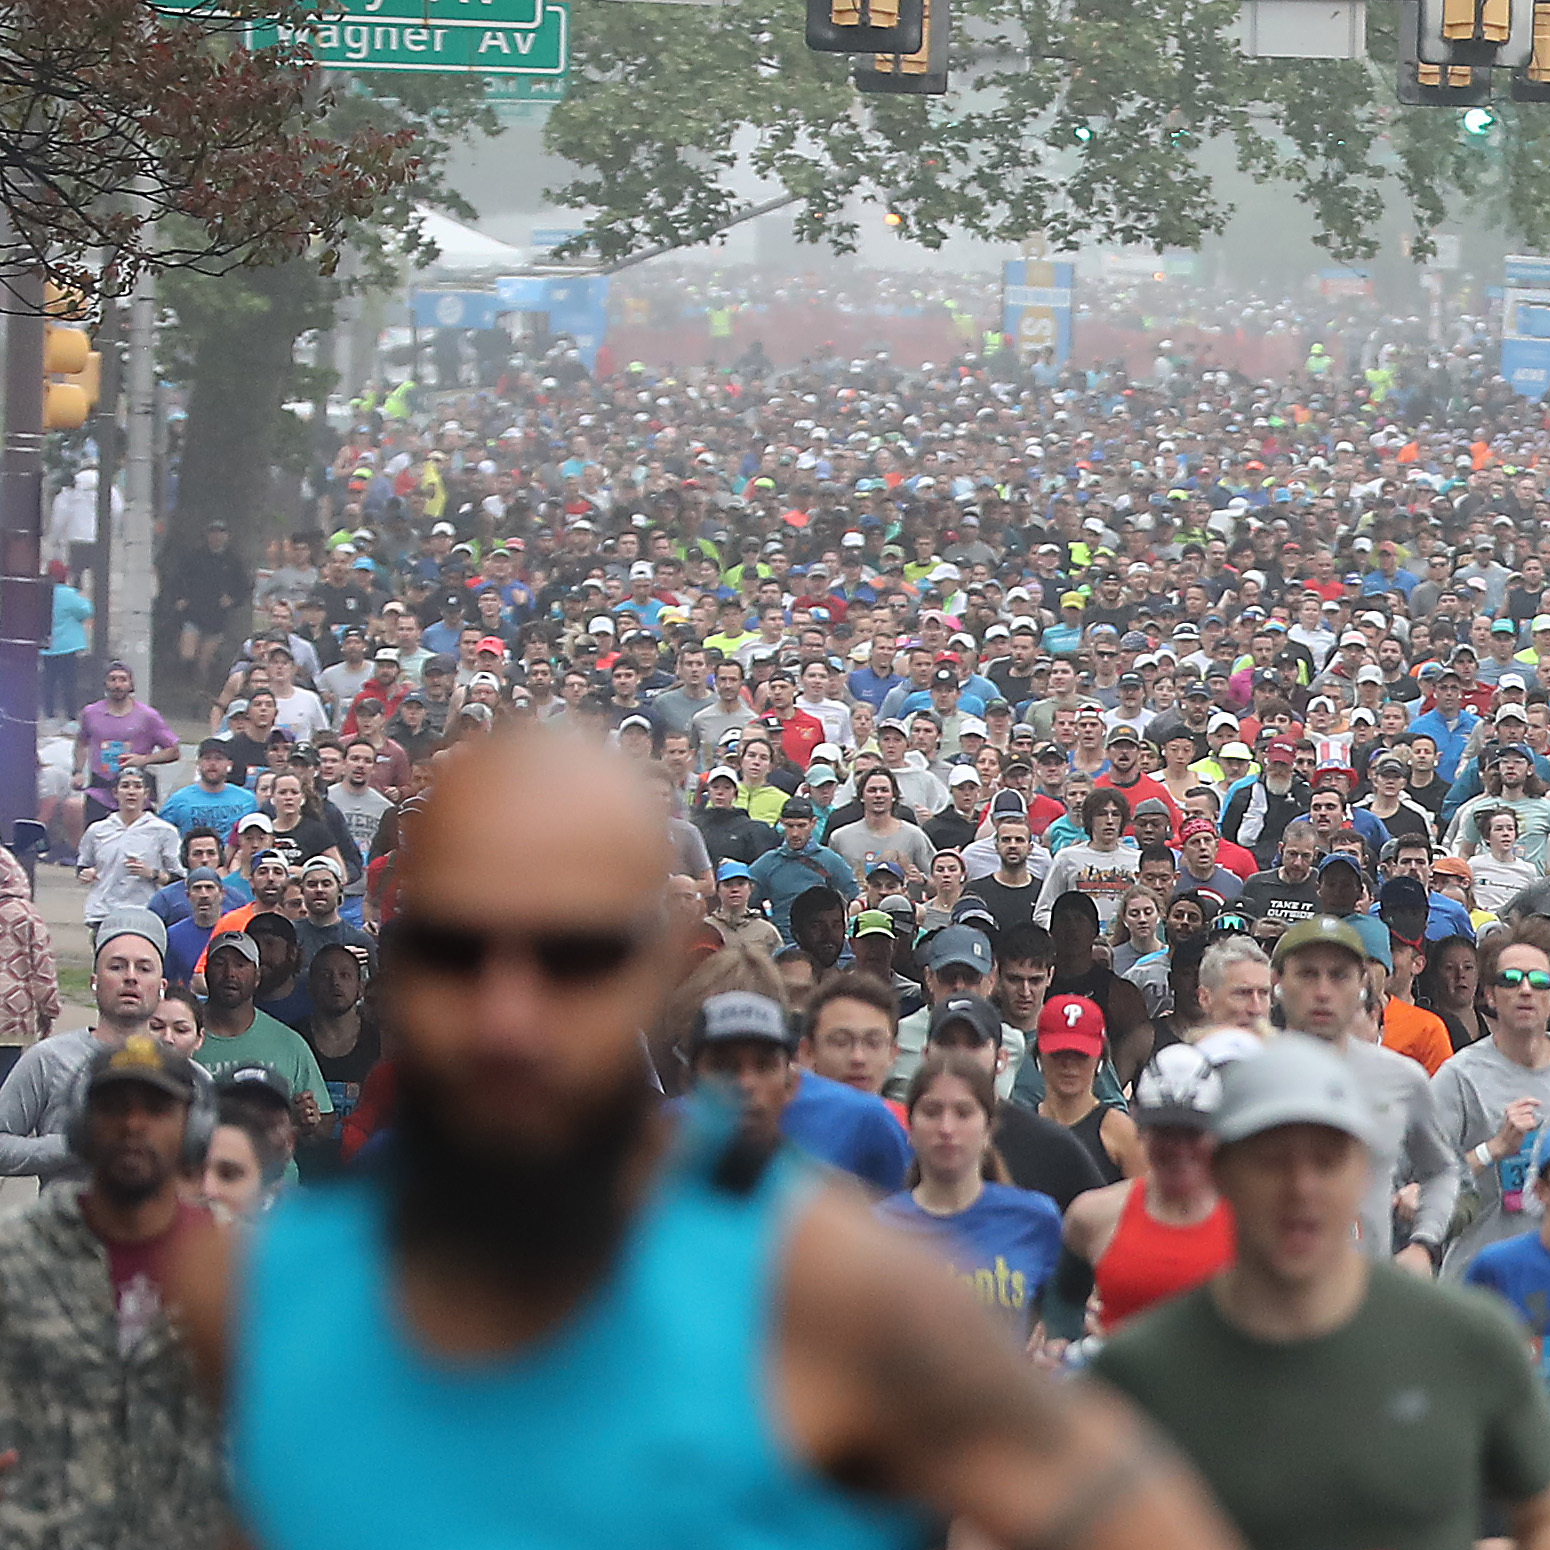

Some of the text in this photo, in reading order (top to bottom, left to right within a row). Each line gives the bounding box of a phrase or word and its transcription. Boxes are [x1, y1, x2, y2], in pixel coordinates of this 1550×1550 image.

[276, 23, 537, 59] Wagner Av
[1270, 899, 1314, 911] TAKE IT
[1266, 908, 1316, 921] OUTSIDE
